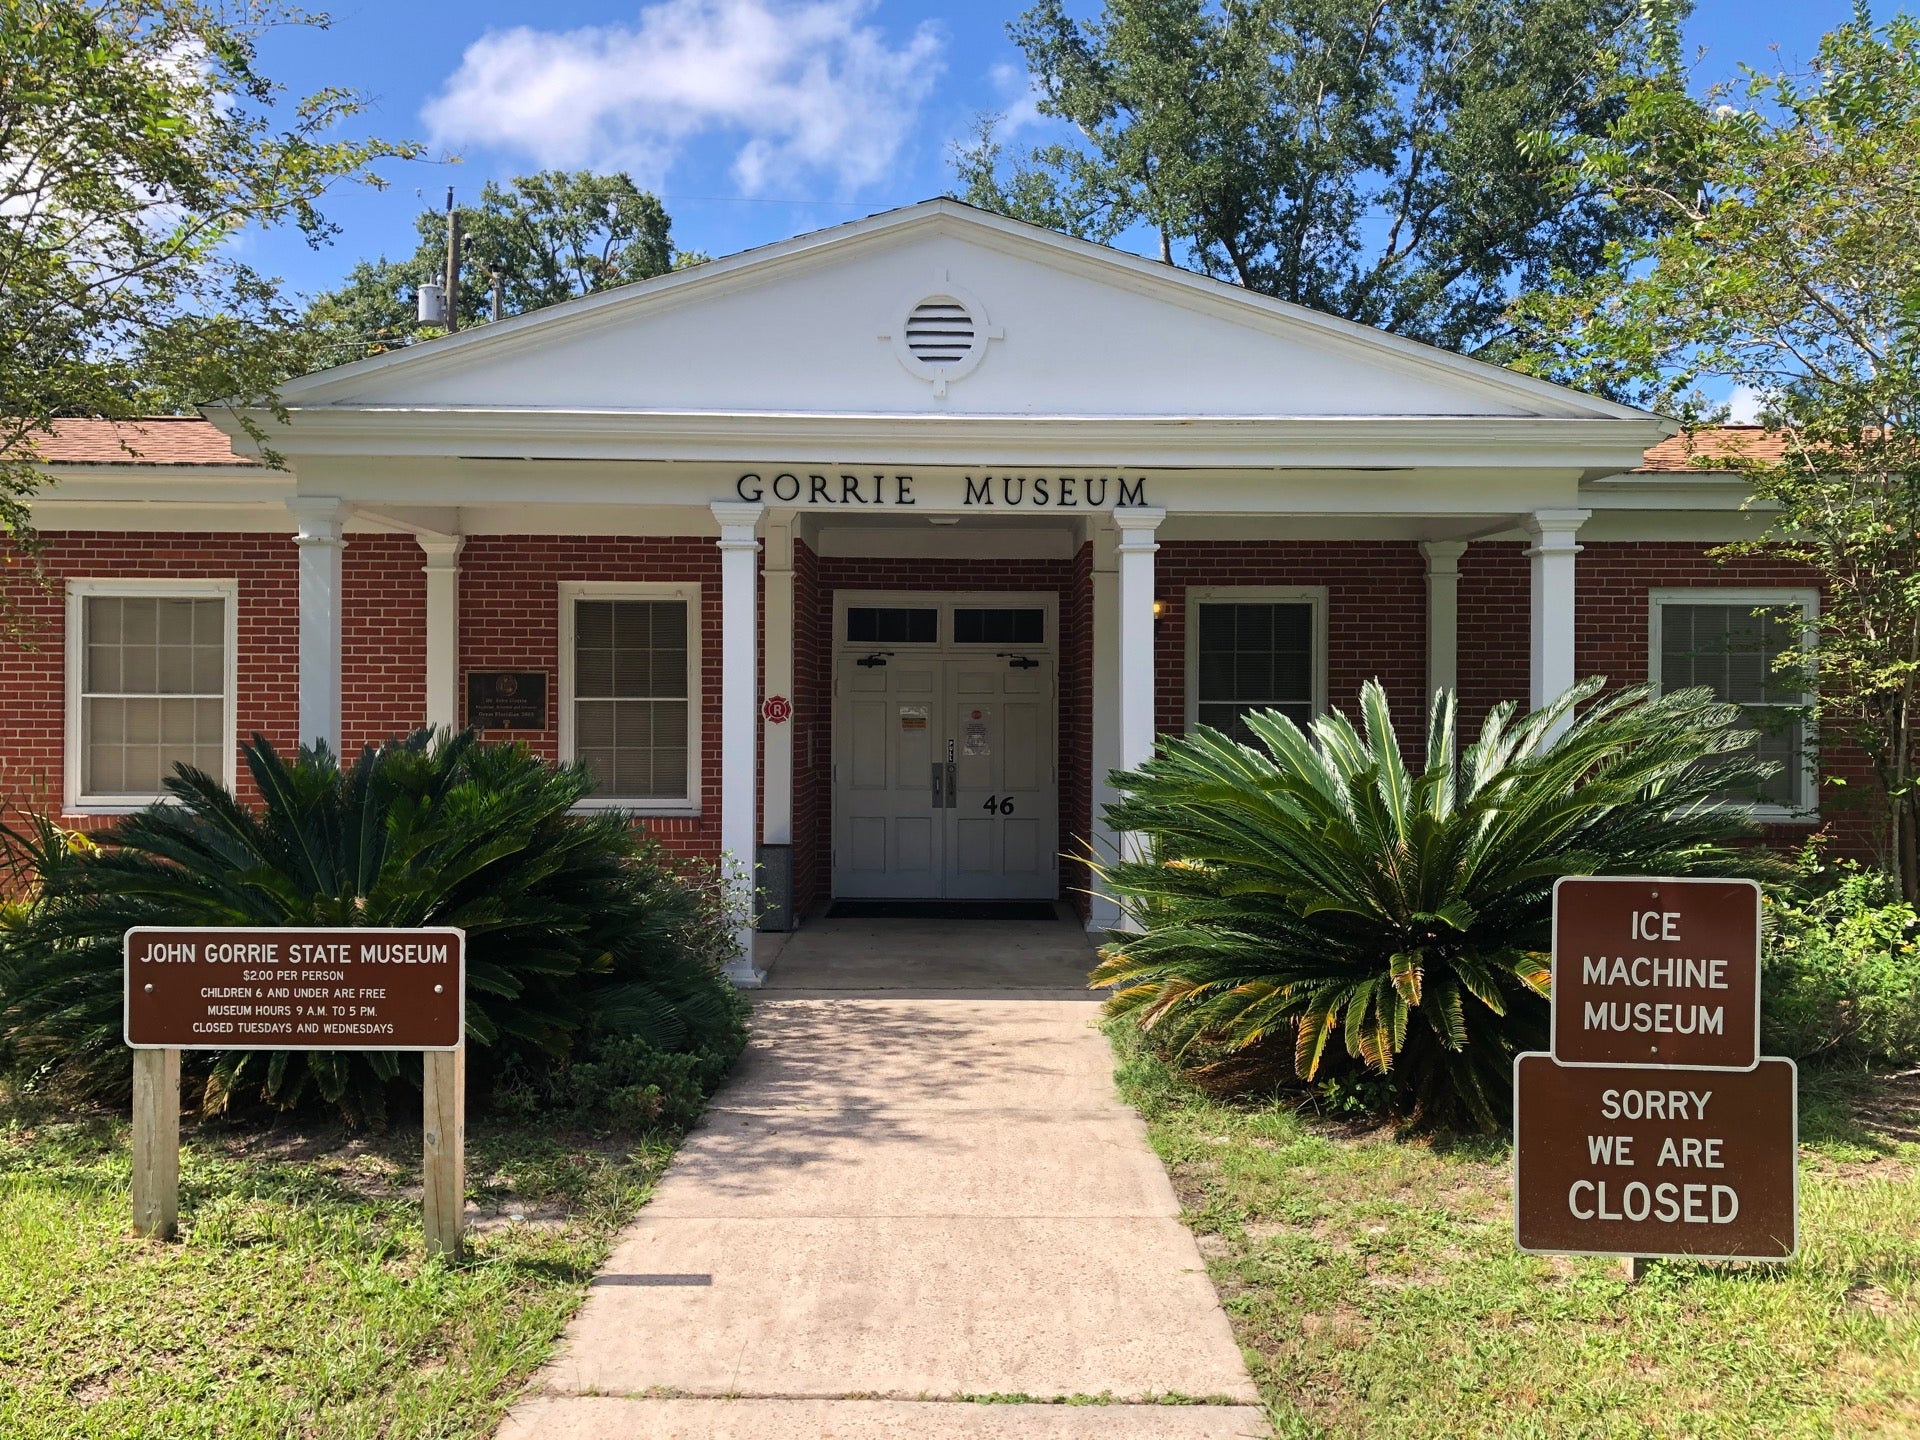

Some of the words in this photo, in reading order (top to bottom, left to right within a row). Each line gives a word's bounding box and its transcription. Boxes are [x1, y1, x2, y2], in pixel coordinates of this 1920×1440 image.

[737, 473, 916, 505] GORRIE
[964, 476, 1149, 507] MUSEUM
[773, 704, 782, 715] R
[982, 795, 1015, 816] 46
[1630, 910, 1682, 942] ICE
[140, 943, 196, 963] JOHN
[204, 943, 279, 963] GORRIE
[288, 944, 352, 964] STATE
[360, 944, 447, 964] MUSEUM
[242, 969, 274, 982] $2.00
[276, 970, 298, 981] PER
[301, 970, 344, 981] PERSON
[1582, 955, 1729, 990] MACHINE
[200, 987, 252, 999] CHILDREN
[255, 987, 263, 999] 6
[266, 987, 290, 999] AND
[293, 987, 329, 999] UNDER
[333, 988, 356, 999] ARE
[359, 988, 387, 1000] FREE
[207, 1004, 252, 1016] MUSEUM
[255, 1005, 292, 1016] HOURS
[295, 1005, 304, 1016] 9
[306, 1005, 328, 1017] A.M.
[331, 1005, 346, 1017] TO
[349, 1005, 357, 1017] 5
[359, 1005, 378, 1017] P.M.
[1583, 1001, 1724, 1035] MUSEUM
[192, 1022, 234, 1033] CLOSED
[237, 1022, 293, 1034] TUESDAYS
[296, 1022, 319, 1034] AND
[323, 1022, 394, 1035] WEDNESDAYS
[1601, 1089, 1713, 1120] SORRY
[1587, 1135, 1635, 1166] WE
[1656, 1137, 1725, 1169] ARE
[1568, 1179, 1739, 1224] CLOSED
